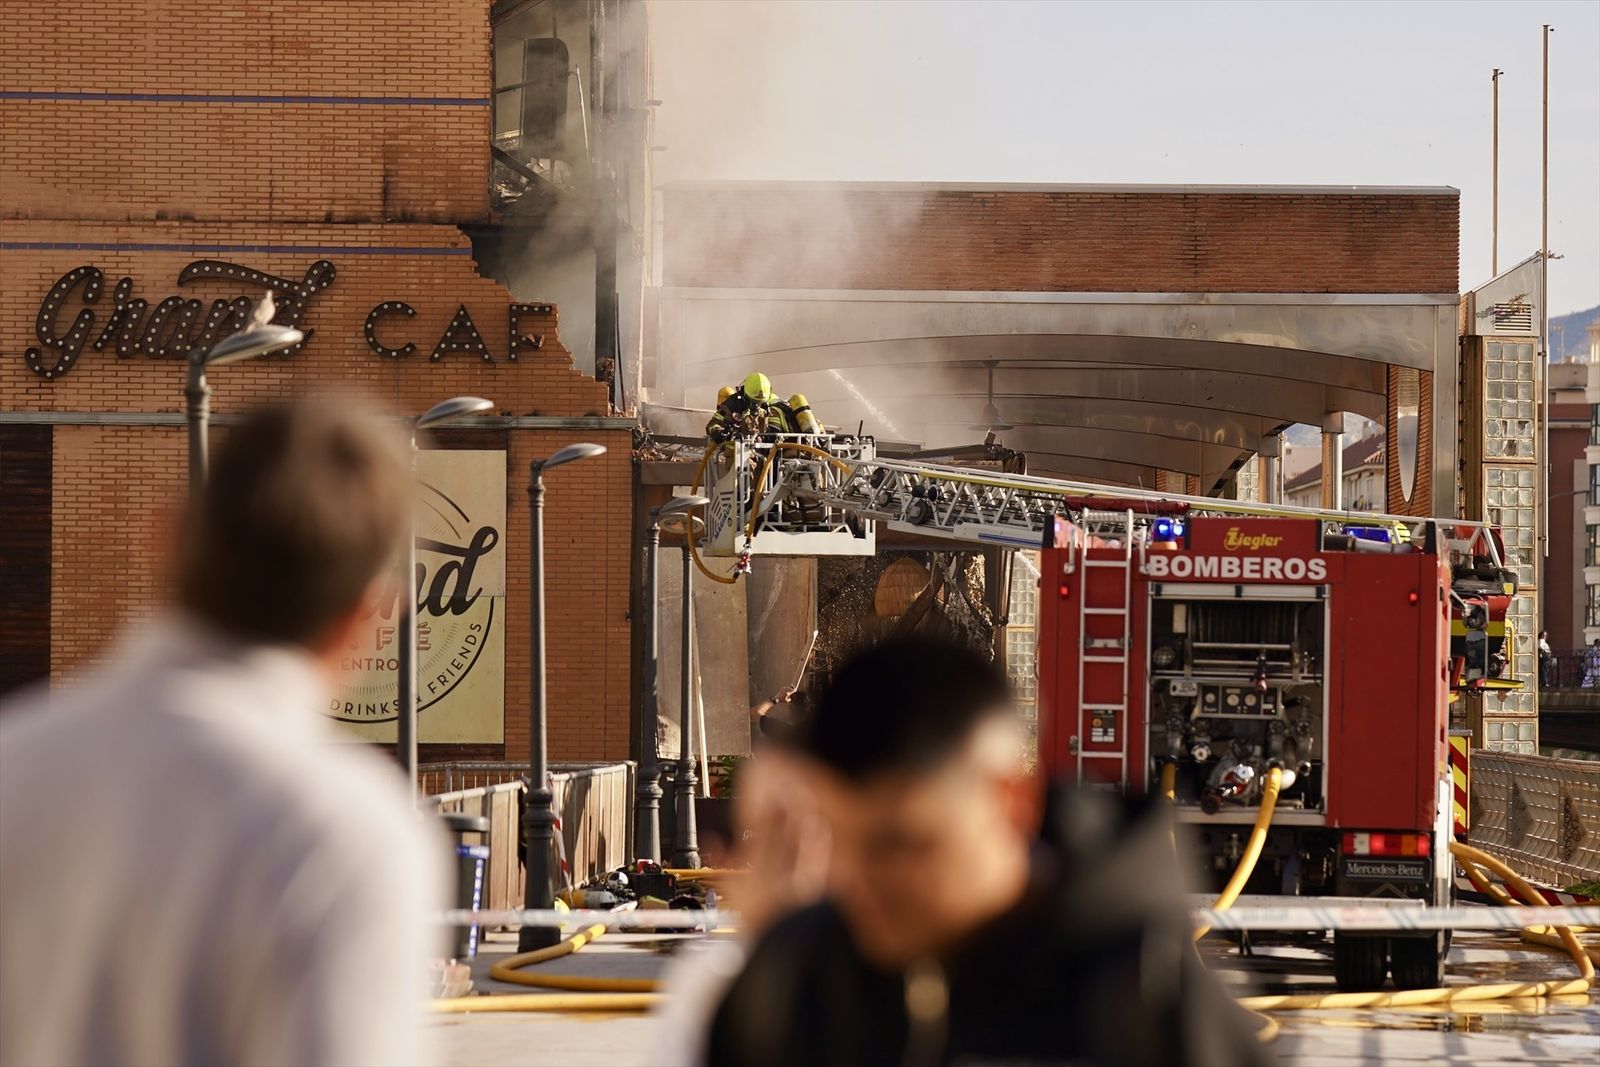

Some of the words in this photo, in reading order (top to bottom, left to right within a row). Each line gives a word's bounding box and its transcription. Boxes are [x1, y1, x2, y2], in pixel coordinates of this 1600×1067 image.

[25, 260, 337, 378] Grand
[714, 503, 732, 540] MAGIRUS
[1224, 527, 1283, 551] Ziegler
[1149, 555, 1327, 580] BOMBEROS
[427, 623, 482, 694] FRIENDS
[1347, 863, 1424, 876] Mercedes-Benz
